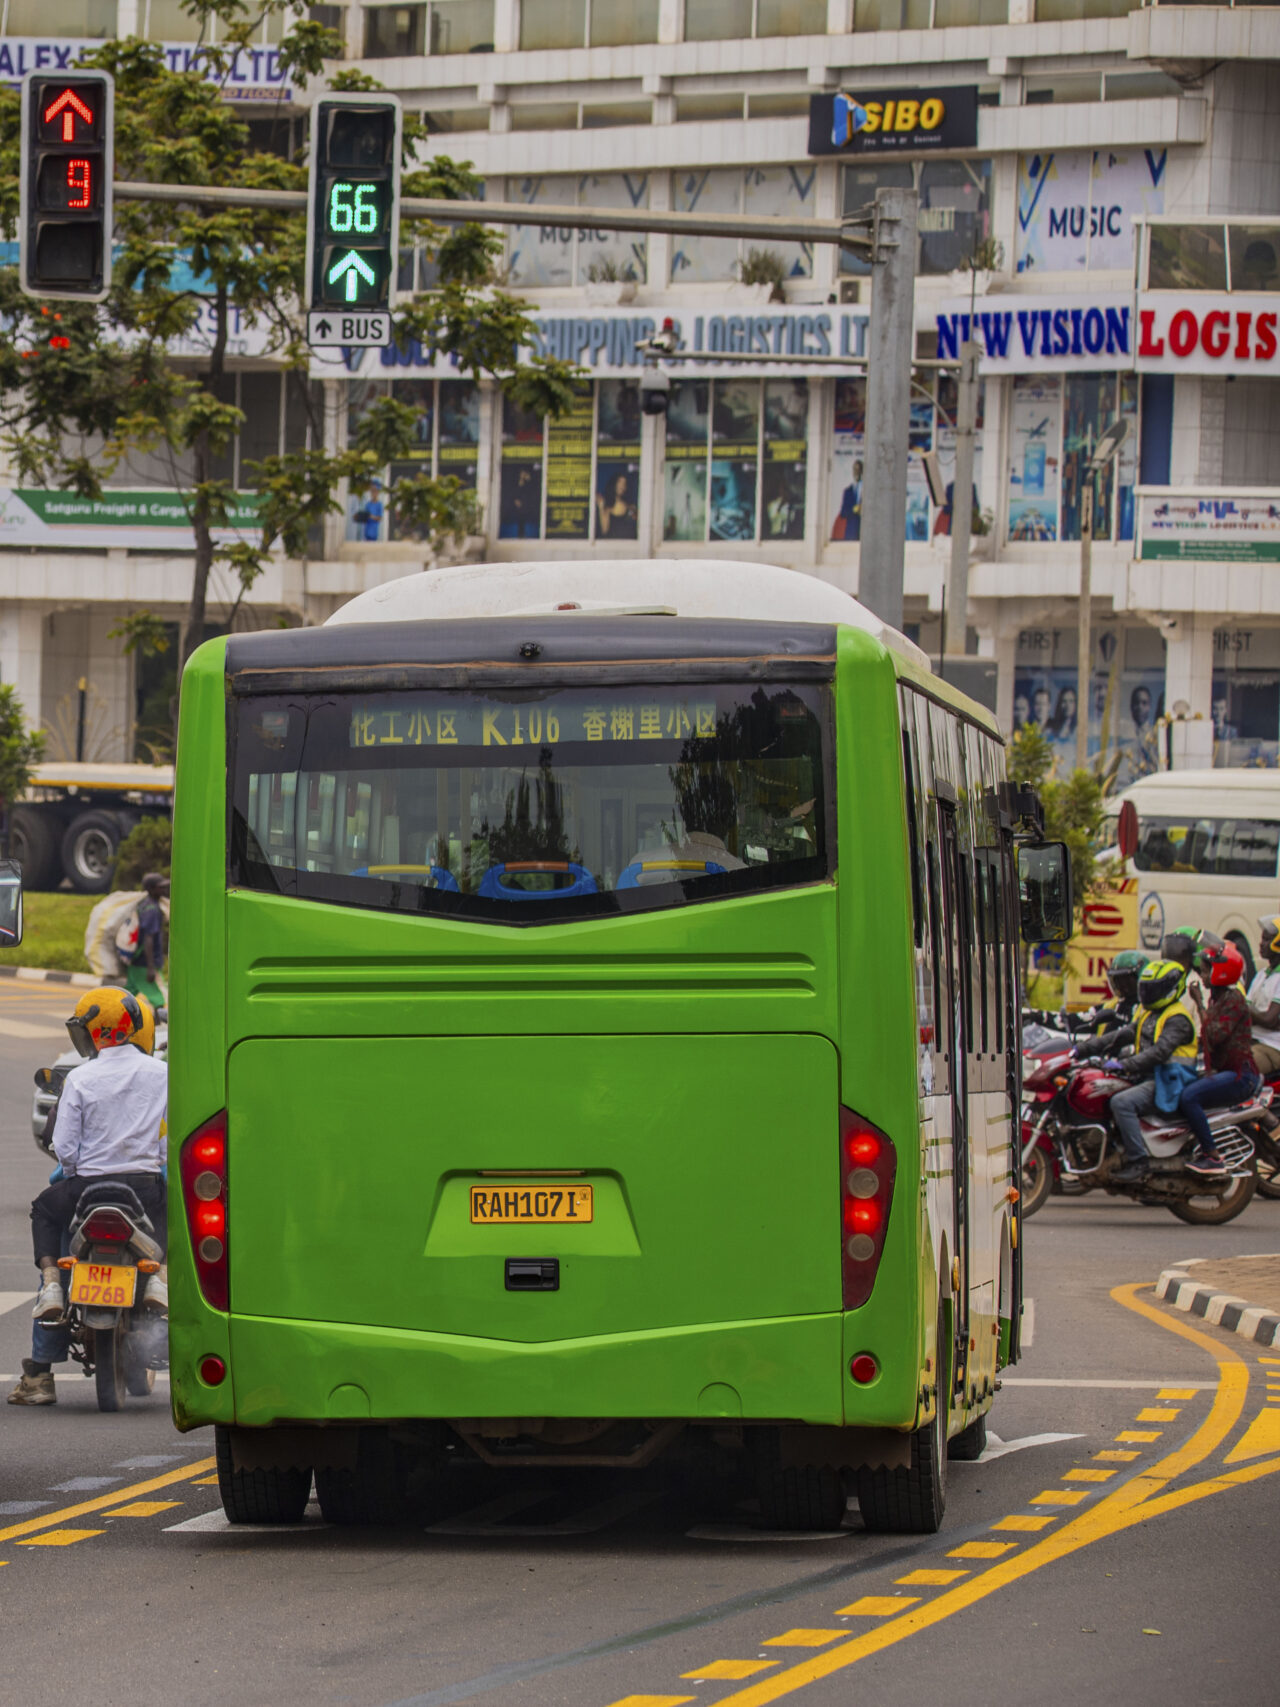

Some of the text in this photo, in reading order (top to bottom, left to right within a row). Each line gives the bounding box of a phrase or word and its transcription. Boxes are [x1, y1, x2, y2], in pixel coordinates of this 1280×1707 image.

[231, 50, 288, 82] LTD
[67, 159, 92, 208] 9
[330, 183, 378, 233] 66
[1048, 205, 1122, 237] MUSIC
[342, 318, 383, 340] BUS
[694, 315, 832, 365] LOGISTICS
[840, 315, 870, 362] LT
[1018, 306, 1131, 357] VISION
[1138, 310, 1278, 360] LOGIS
[94, 503, 136, 517] Freight
[1198, 501, 1239, 519] NVL
[1019, 631, 1061, 650] FIRST
[482, 704, 561, 746] K106
[88, 1265, 112, 1283] RH
